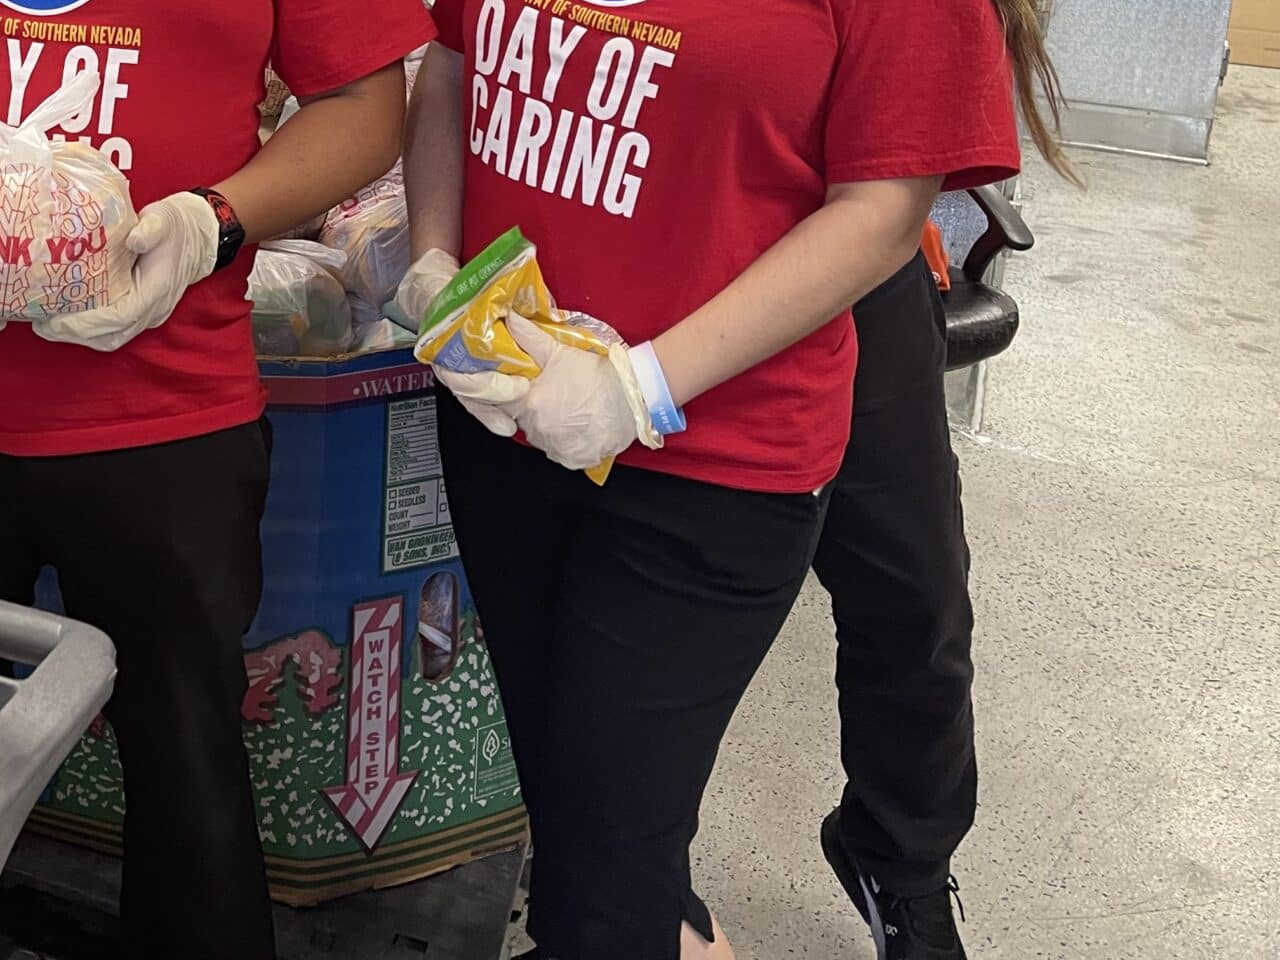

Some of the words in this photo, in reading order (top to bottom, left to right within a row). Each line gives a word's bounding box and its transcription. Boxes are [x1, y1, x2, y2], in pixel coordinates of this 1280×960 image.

[4, 17, 21, 36] OF
[22, 20, 87, 43] SOUTHERN
[90, 25, 142, 47] NEVADA
[553, 0, 570, 17] OF
[568, 4, 629, 37] SOUTHERN
[631, 20, 682, 50] NEVADA
[61, 45, 140, 135] OF
[586, 37, 675, 129] OF
[470, 73, 650, 218] CARING
[46, 226, 107, 265] YOU
[43, 249, 109, 287] YOU
[42, 269, 110, 309] YOU
[398, 486, 421, 497] SEEDED
[398, 495, 426, 508] SEEDLESS
[388, 521, 410, 532] WEIGHT
[389, 510, 408, 520] COUNT
[388, 540, 406, 553] VAN
[367, 639, 384, 721] WATCH
[365, 733, 380, 795] STEP
